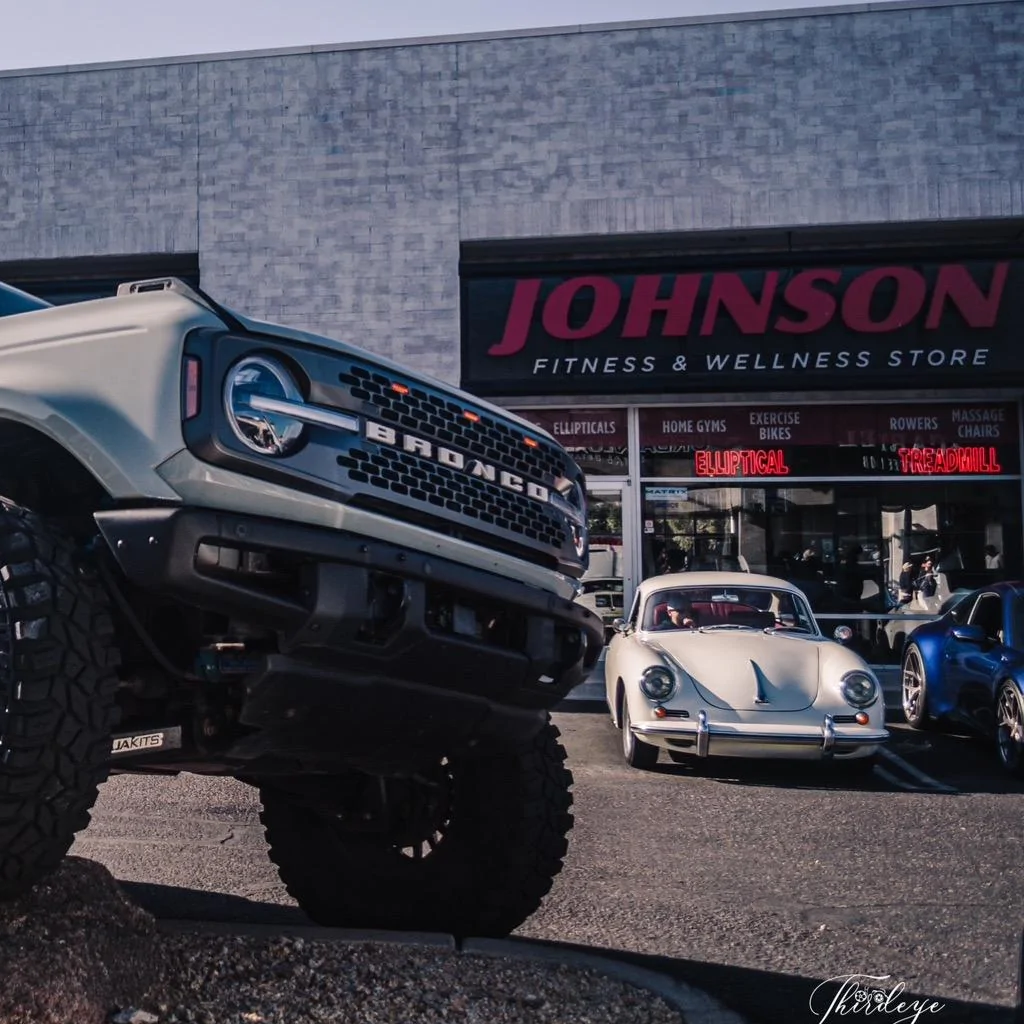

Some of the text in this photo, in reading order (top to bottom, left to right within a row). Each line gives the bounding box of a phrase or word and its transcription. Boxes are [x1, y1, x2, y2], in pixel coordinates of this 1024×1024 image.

[488, 262, 1010, 356] JOHNSON
[532, 348, 989, 375] FITNESS & WELLNESS STORE
[749, 411, 801, 426] EXERCISE
[951, 408, 1005, 423] MASSAGE
[553, 420, 616, 435] ELLIPTICALS
[662, 419, 726, 434] HOME GYMS
[889, 416, 939, 431] ROWERS
[957, 424, 1000, 438] CHAIRS
[759, 426, 792, 441] BIKES
[365, 420, 550, 502] BRONCO
[694, 448, 790, 477] ELLIPTICAL
[897, 446, 1002, 474] TREADMILL
